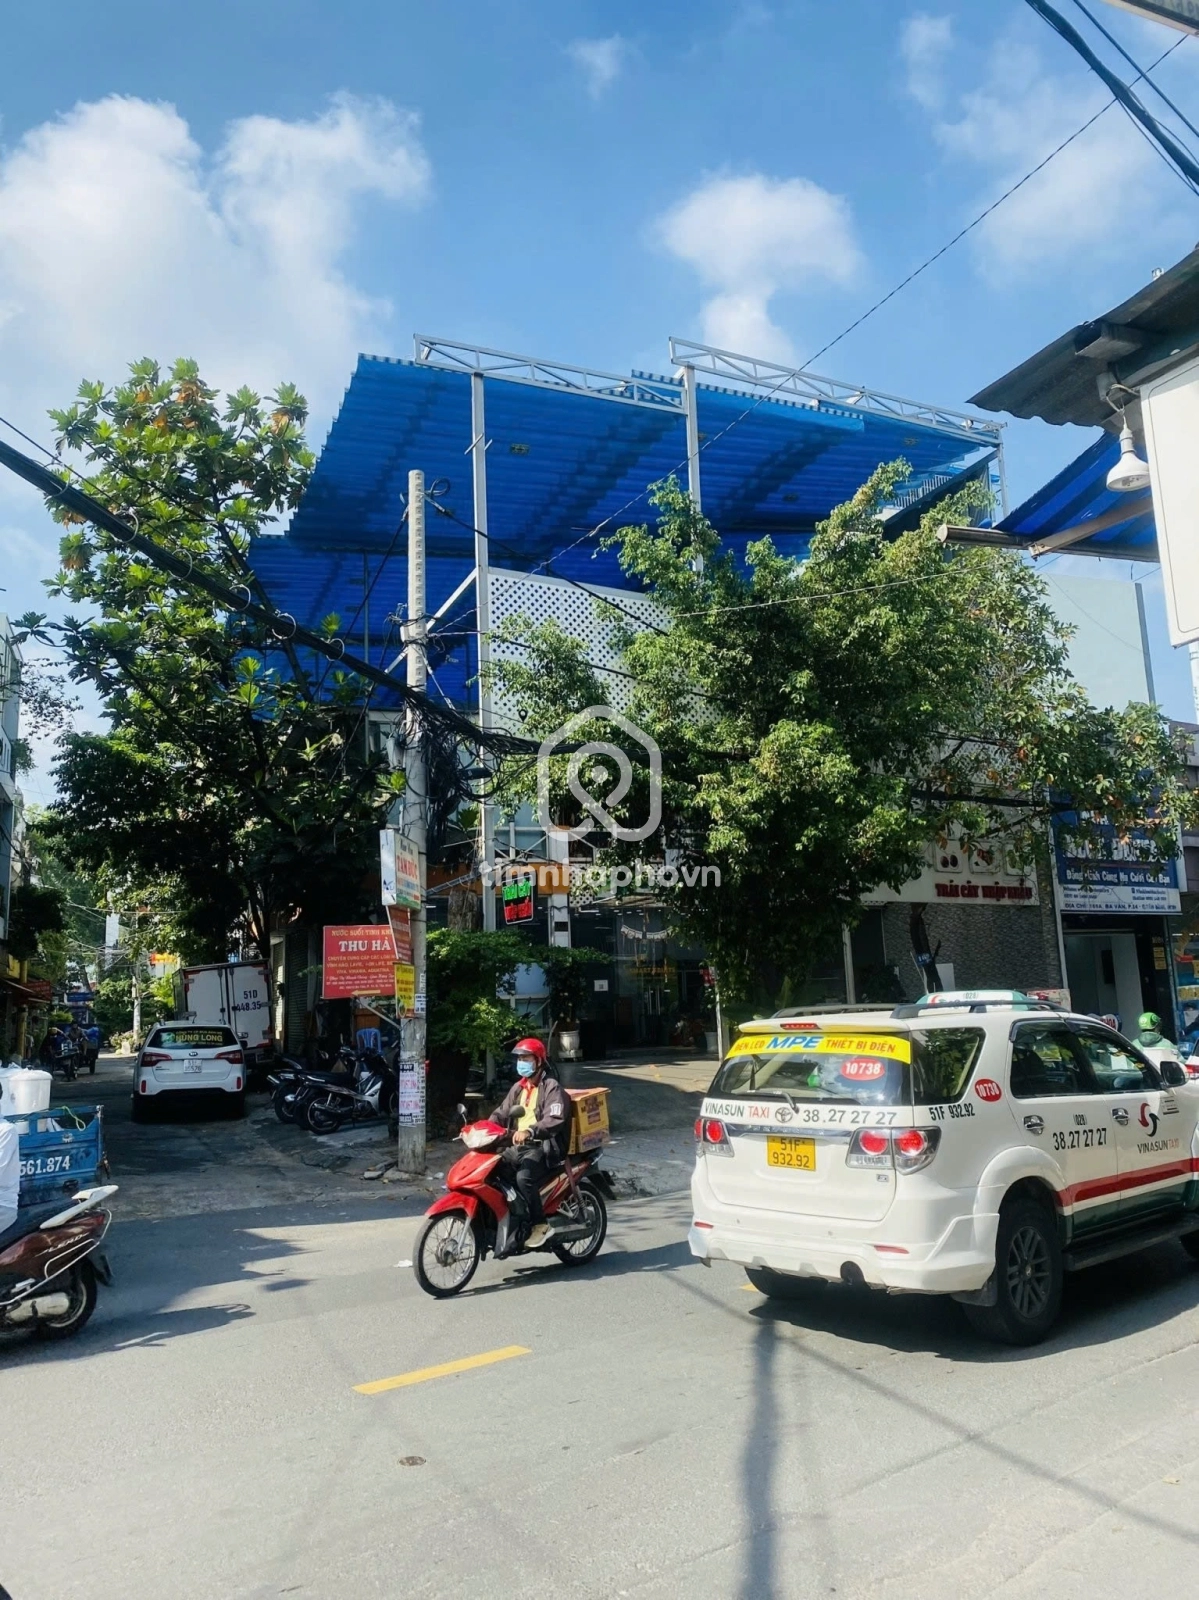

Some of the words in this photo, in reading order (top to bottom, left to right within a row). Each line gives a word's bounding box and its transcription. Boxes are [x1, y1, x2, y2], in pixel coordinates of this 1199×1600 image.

[1158, 874, 1170, 886] Bạn
[339, 940, 368, 952] THU
[372, 936, 392, 950] HÀ
[243, 990, 258, 1000] 51D
[201, 1034, 222, 1042] LONG
[750, 1040, 766, 1050] LED
[766, 1036, 824, 1050] MPE
[826, 1038, 853, 1048] THIẾT
[856, 1040, 868, 1052] BỊ
[869, 1040, 897, 1053] ĐIỆN
[845, 1062, 882, 1076] 10738
[976, 1082, 1000, 1097] 10738
[704, 1102, 744, 1118] VINASUN
[748, 1105, 770, 1118] TAXI
[850, 1111, 870, 1124] 27
[875, 1112, 897, 1125] 27
[929, 1106, 945, 1120] 51F
[948, 1103, 975, 1118] 932.92
[780, 1138, 800, 1152] 51F
[1053, 1130, 1080, 1150] 38.27
[1083, 1129, 1094, 1147] 27
[1096, 1128, 1106, 1146] 27
[772, 1152, 810, 1168] 932.92
